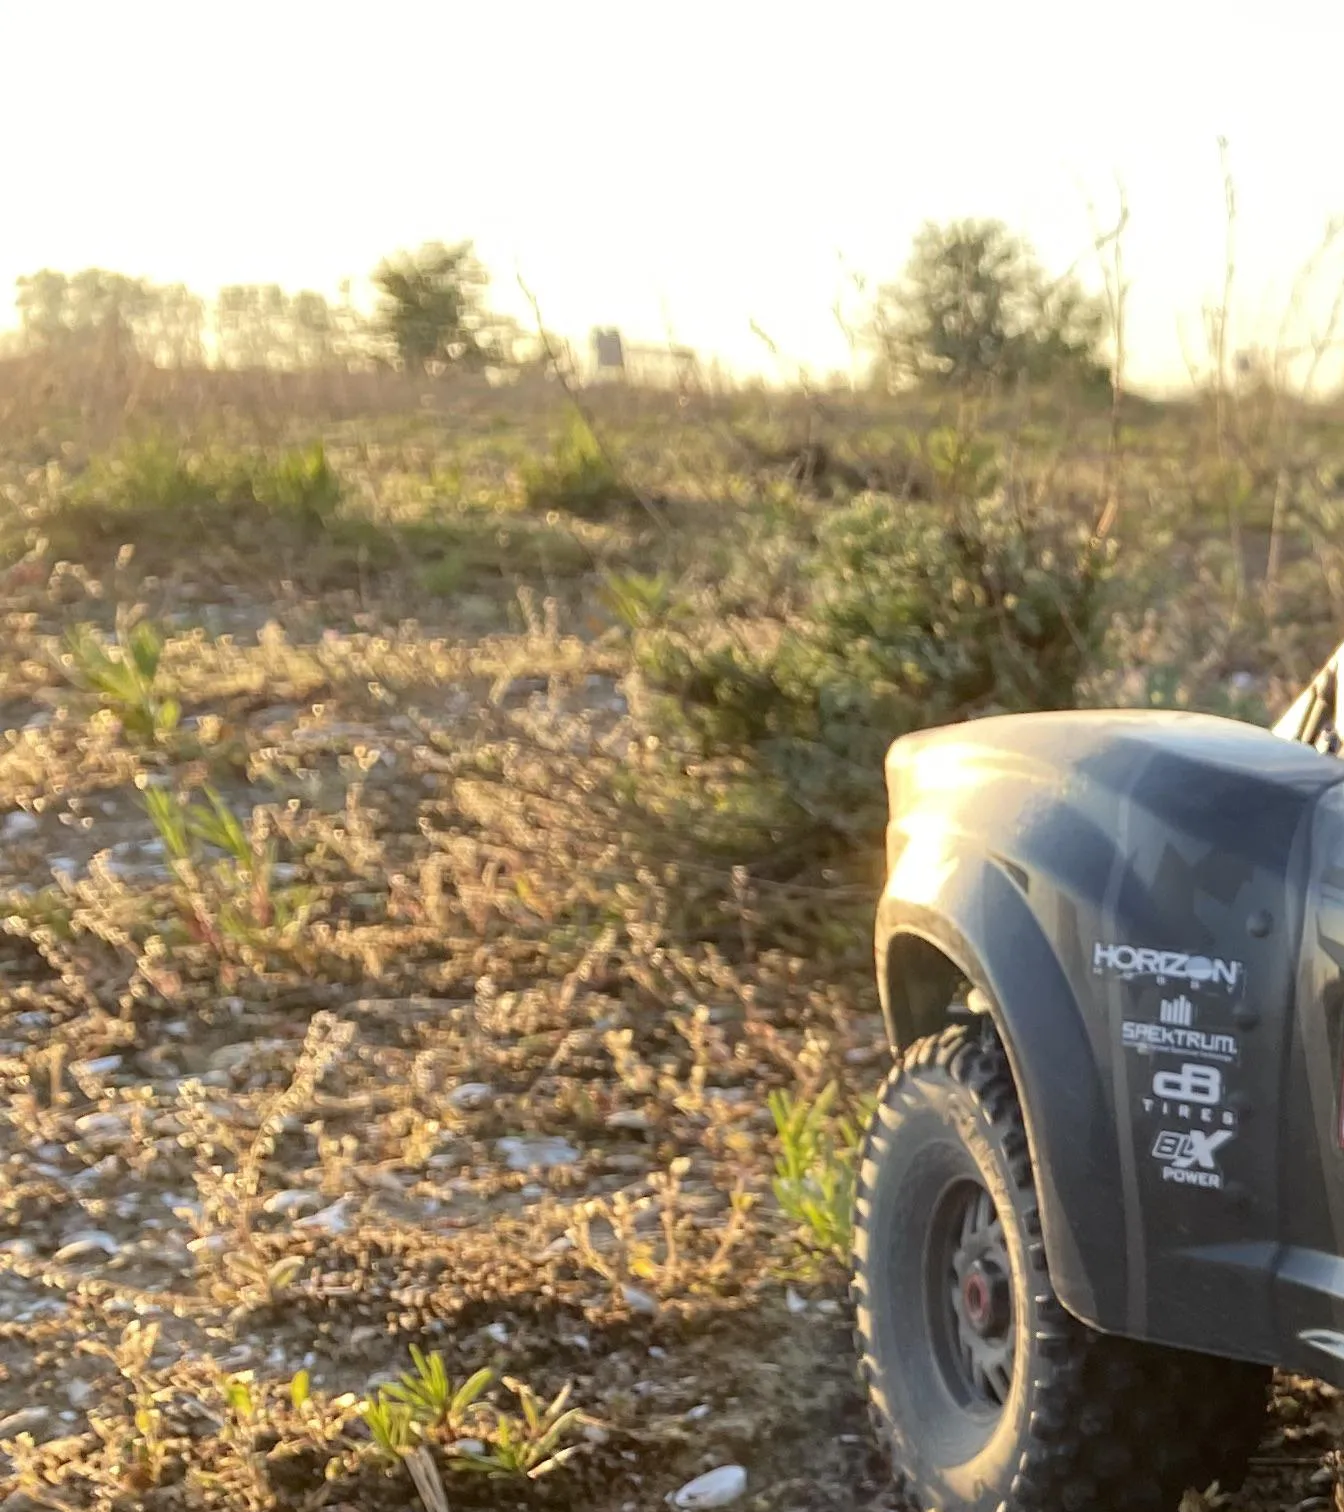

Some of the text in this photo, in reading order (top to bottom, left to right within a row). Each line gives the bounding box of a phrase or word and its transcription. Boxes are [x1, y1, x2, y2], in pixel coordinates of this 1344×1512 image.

[1094, 942, 1238, 985] HORIZON
[1122, 1022, 1236, 1054] SPEKTRUM
[1142, 1098, 1234, 1126] TIRES
[1163, 1166, 1220, 1189] POWER
